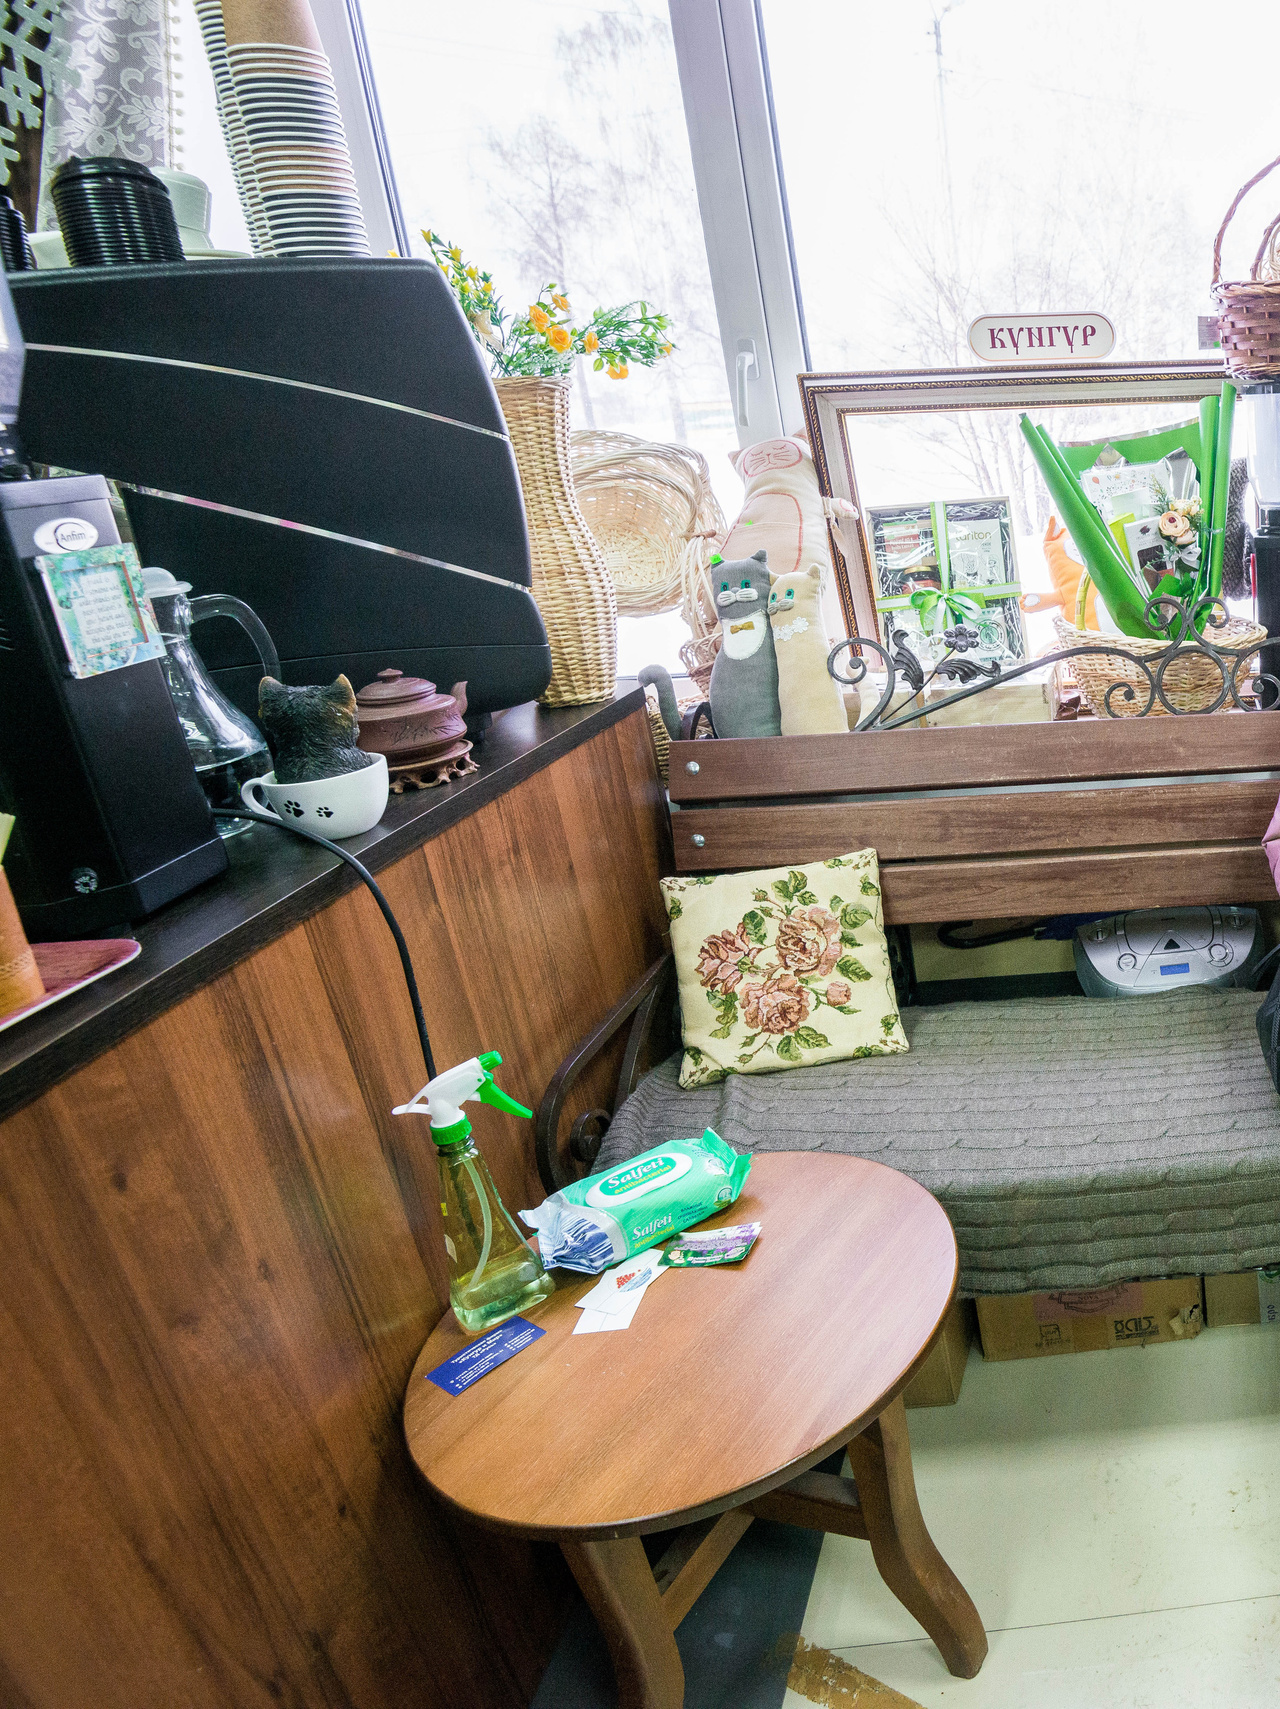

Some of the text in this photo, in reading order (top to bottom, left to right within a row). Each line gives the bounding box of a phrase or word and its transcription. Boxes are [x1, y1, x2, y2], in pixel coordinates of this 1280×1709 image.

[986, 324, 1097, 355] КУНГУР
[60, 530, 87, 543] Anfim
[608, 1157, 665, 1189] Salfeti
[614, 1164, 672, 1194] antibacterial
[632, 1212, 672, 1241] Salfeti
